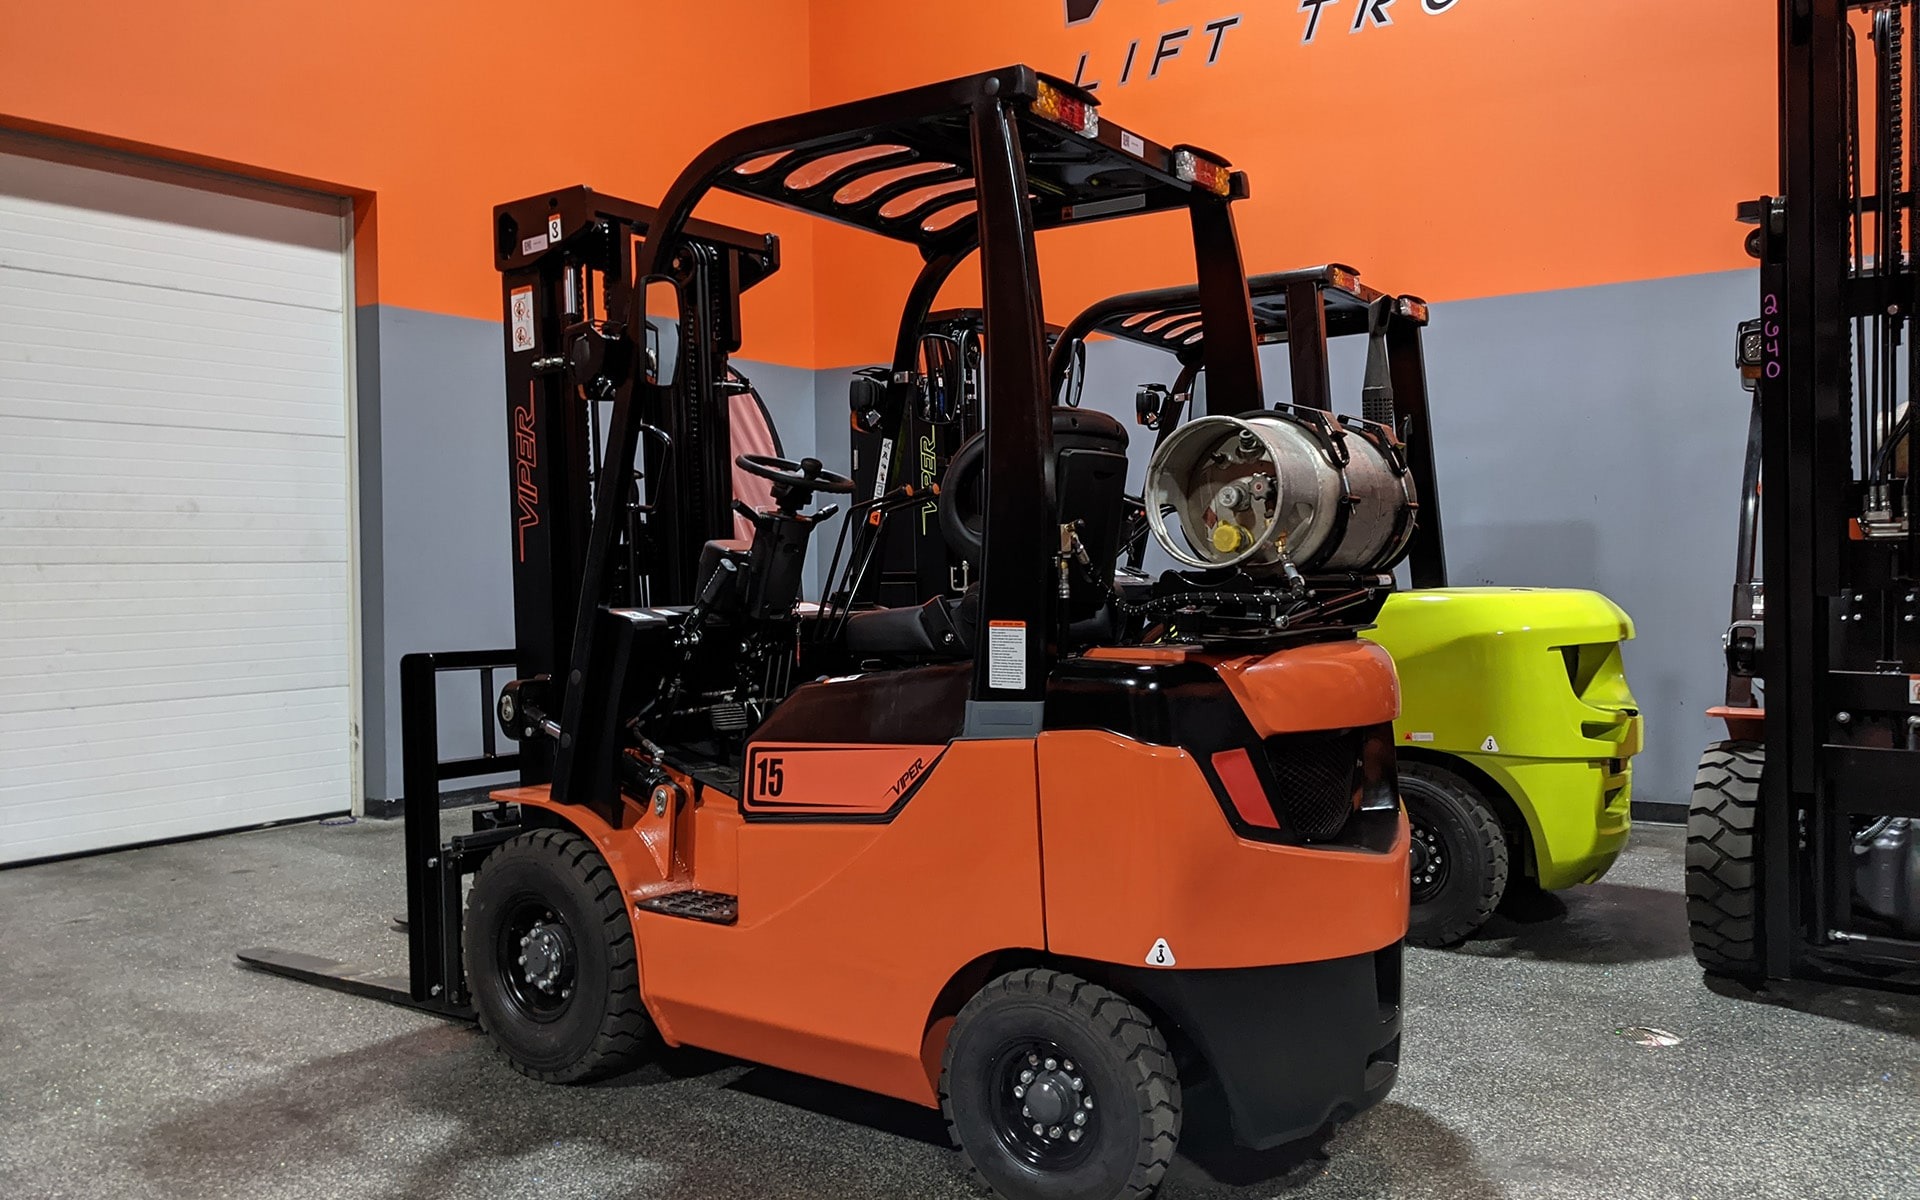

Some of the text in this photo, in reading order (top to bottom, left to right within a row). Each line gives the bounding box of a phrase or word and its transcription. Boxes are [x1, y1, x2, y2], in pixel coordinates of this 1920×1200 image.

[1073, 13, 1243, 92] LIFT
[1298, 0, 1458, 45] TR
[1764, 293, 1780, 378] 2640
[514, 405, 540, 530] VIPER
[919, 434, 938, 515] VPER
[757, 758, 784, 797] 15
[884, 756, 927, 796] VIPER
